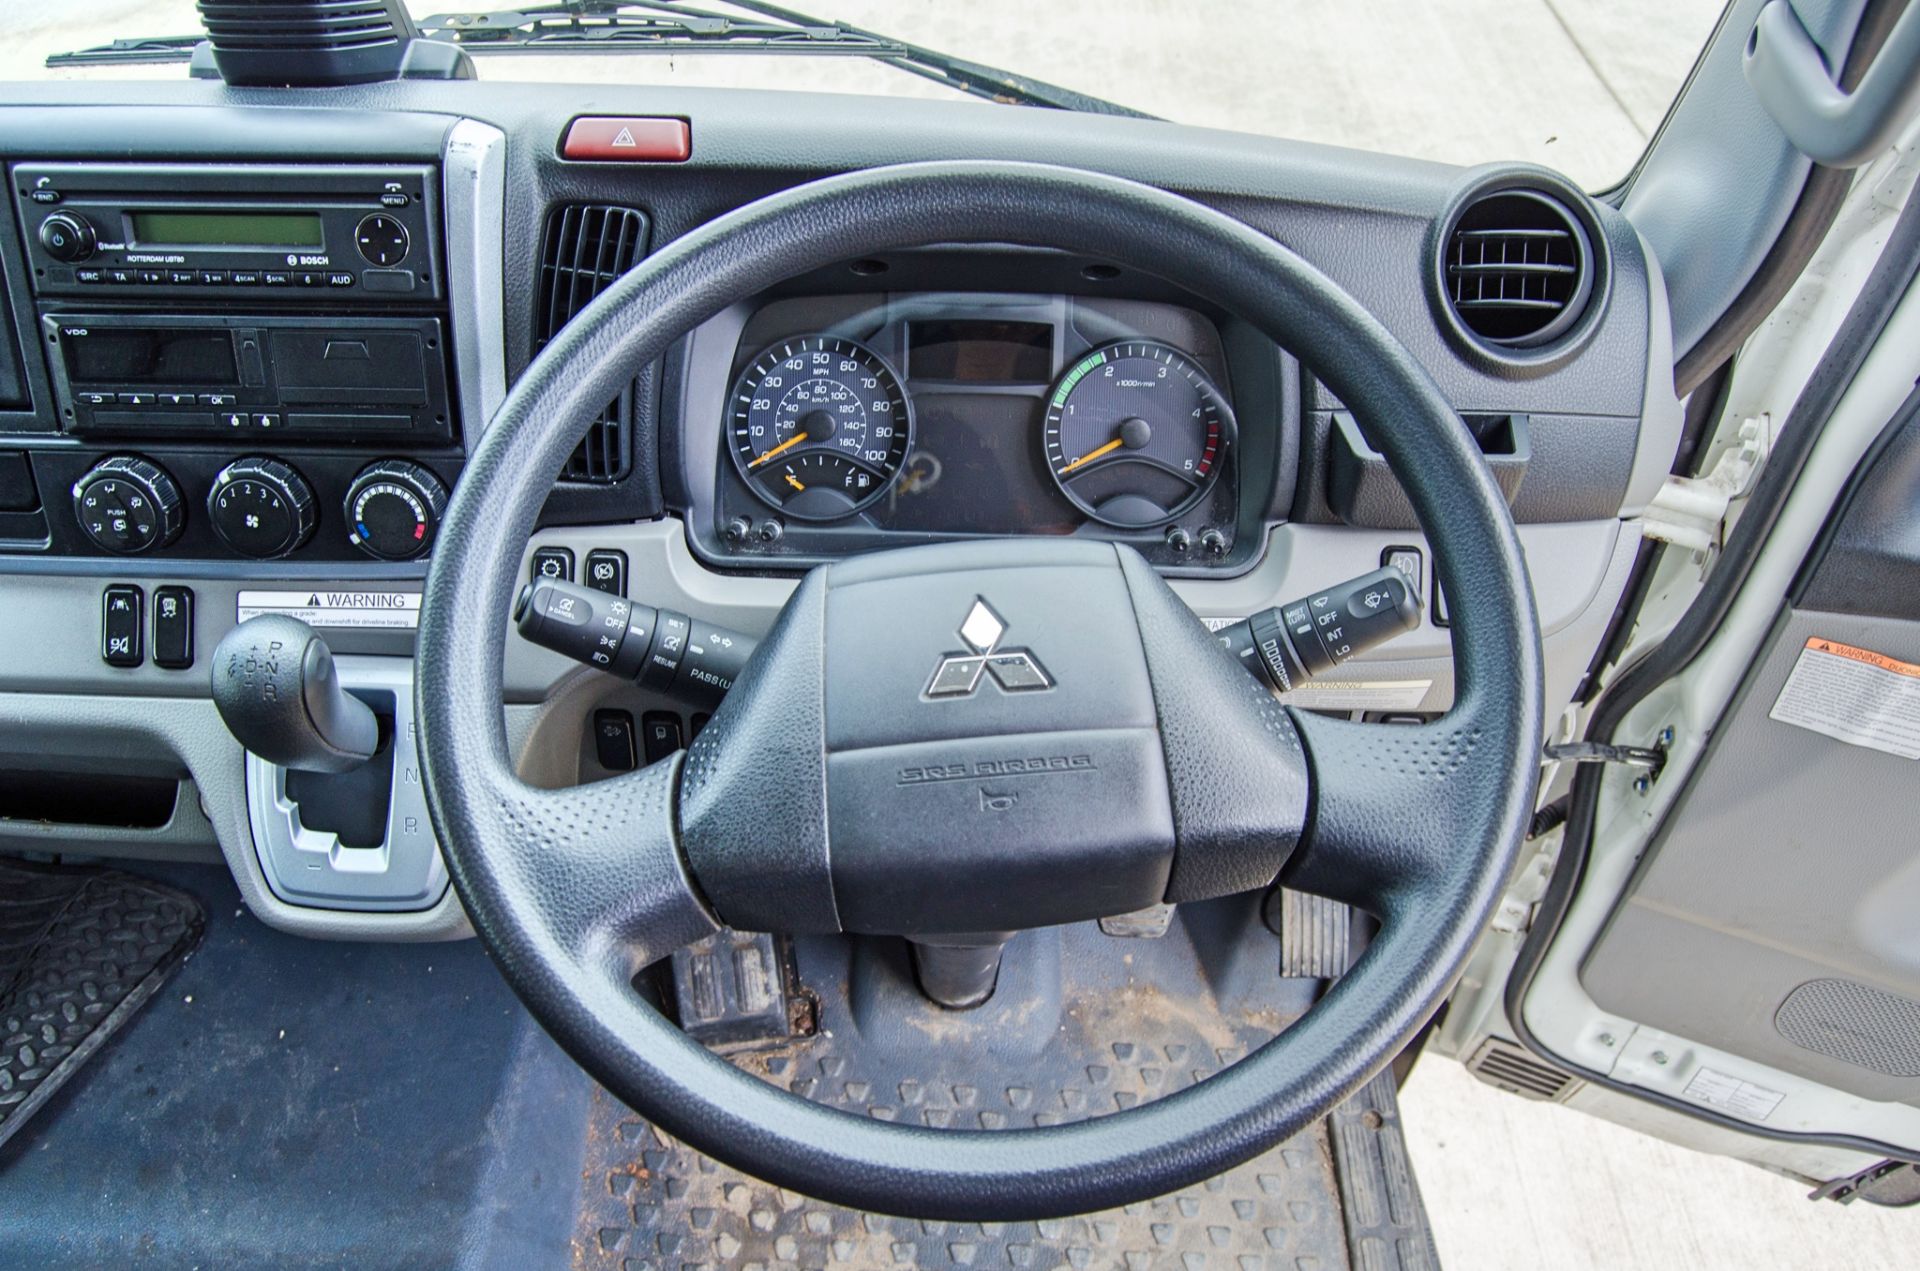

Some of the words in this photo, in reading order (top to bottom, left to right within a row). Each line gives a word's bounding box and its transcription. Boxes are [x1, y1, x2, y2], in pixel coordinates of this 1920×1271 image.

[383, 197, 404, 205] MENU
[300, 256, 328, 265] BOSCH
[80, 272, 99, 280] SRC
[115, 272, 126, 281] TA
[144, 274, 149, 282] 1
[173, 274, 179, 282] 2
[205, 274, 210, 282] 3
[305, 276, 310, 284] 6
[332, 276, 350, 284] AUD
[812, 352, 830, 364] 50
[785, 360, 803, 370] 40
[840, 360, 858, 372] 60
[813, 367, 830, 376] MPH
[1105, 366, 1114, 378] 2
[1158, 366, 1166, 378] 3
[765, 377, 782, 388] 30
[860, 378, 877, 388] 70
[814, 386, 827, 394] 80
[211, 397, 223, 405] OK
[797, 392, 810, 400] 60
[812, 396, 830, 404] km/h
[830, 392, 847, 401] 100
[753, 400, 770, 410] 20
[786, 404, 798, 413] 40
[839, 405, 855, 414] 120
[872, 401, 890, 412] 80
[1070, 405, 1074, 416] 1
[1192, 408, 1200, 418] 4
[782, 421, 796, 430] 20
[844, 422, 860, 430] 140
[751, 426, 764, 436] 10
[876, 427, 893, 438] 90
[839, 438, 856, 447] 160
[864, 450, 886, 462] 100
[1184, 460, 1193, 470] 5
[845, 476, 852, 487] F
[230, 488, 236, 498] 1
[244, 484, 252, 494] 2
[260, 489, 266, 498] 3
[220, 498, 227, 508] 0
[272, 499, 279, 508] 4
[326, 594, 404, 607] WARNING
[554, 608, 575, 620] CANCEL
[1318, 611, 1338, 626] OFF
[605, 616, 625, 630] OFF
[668, 618, 684, 628] SET
[1327, 627, 1344, 642] INT
[269, 641, 283, 654] P
[1336, 644, 1350, 656] LO
[1835, 645, 1885, 666] WARNING
[653, 654, 678, 670] RESUME
[266, 661, 278, 674] N
[264, 683, 277, 702] R
[901, 764, 966, 781] SRS
[974, 754, 1093, 776] AIRBAG
[405, 768, 418, 784] N
[404, 818, 418, 834] R
